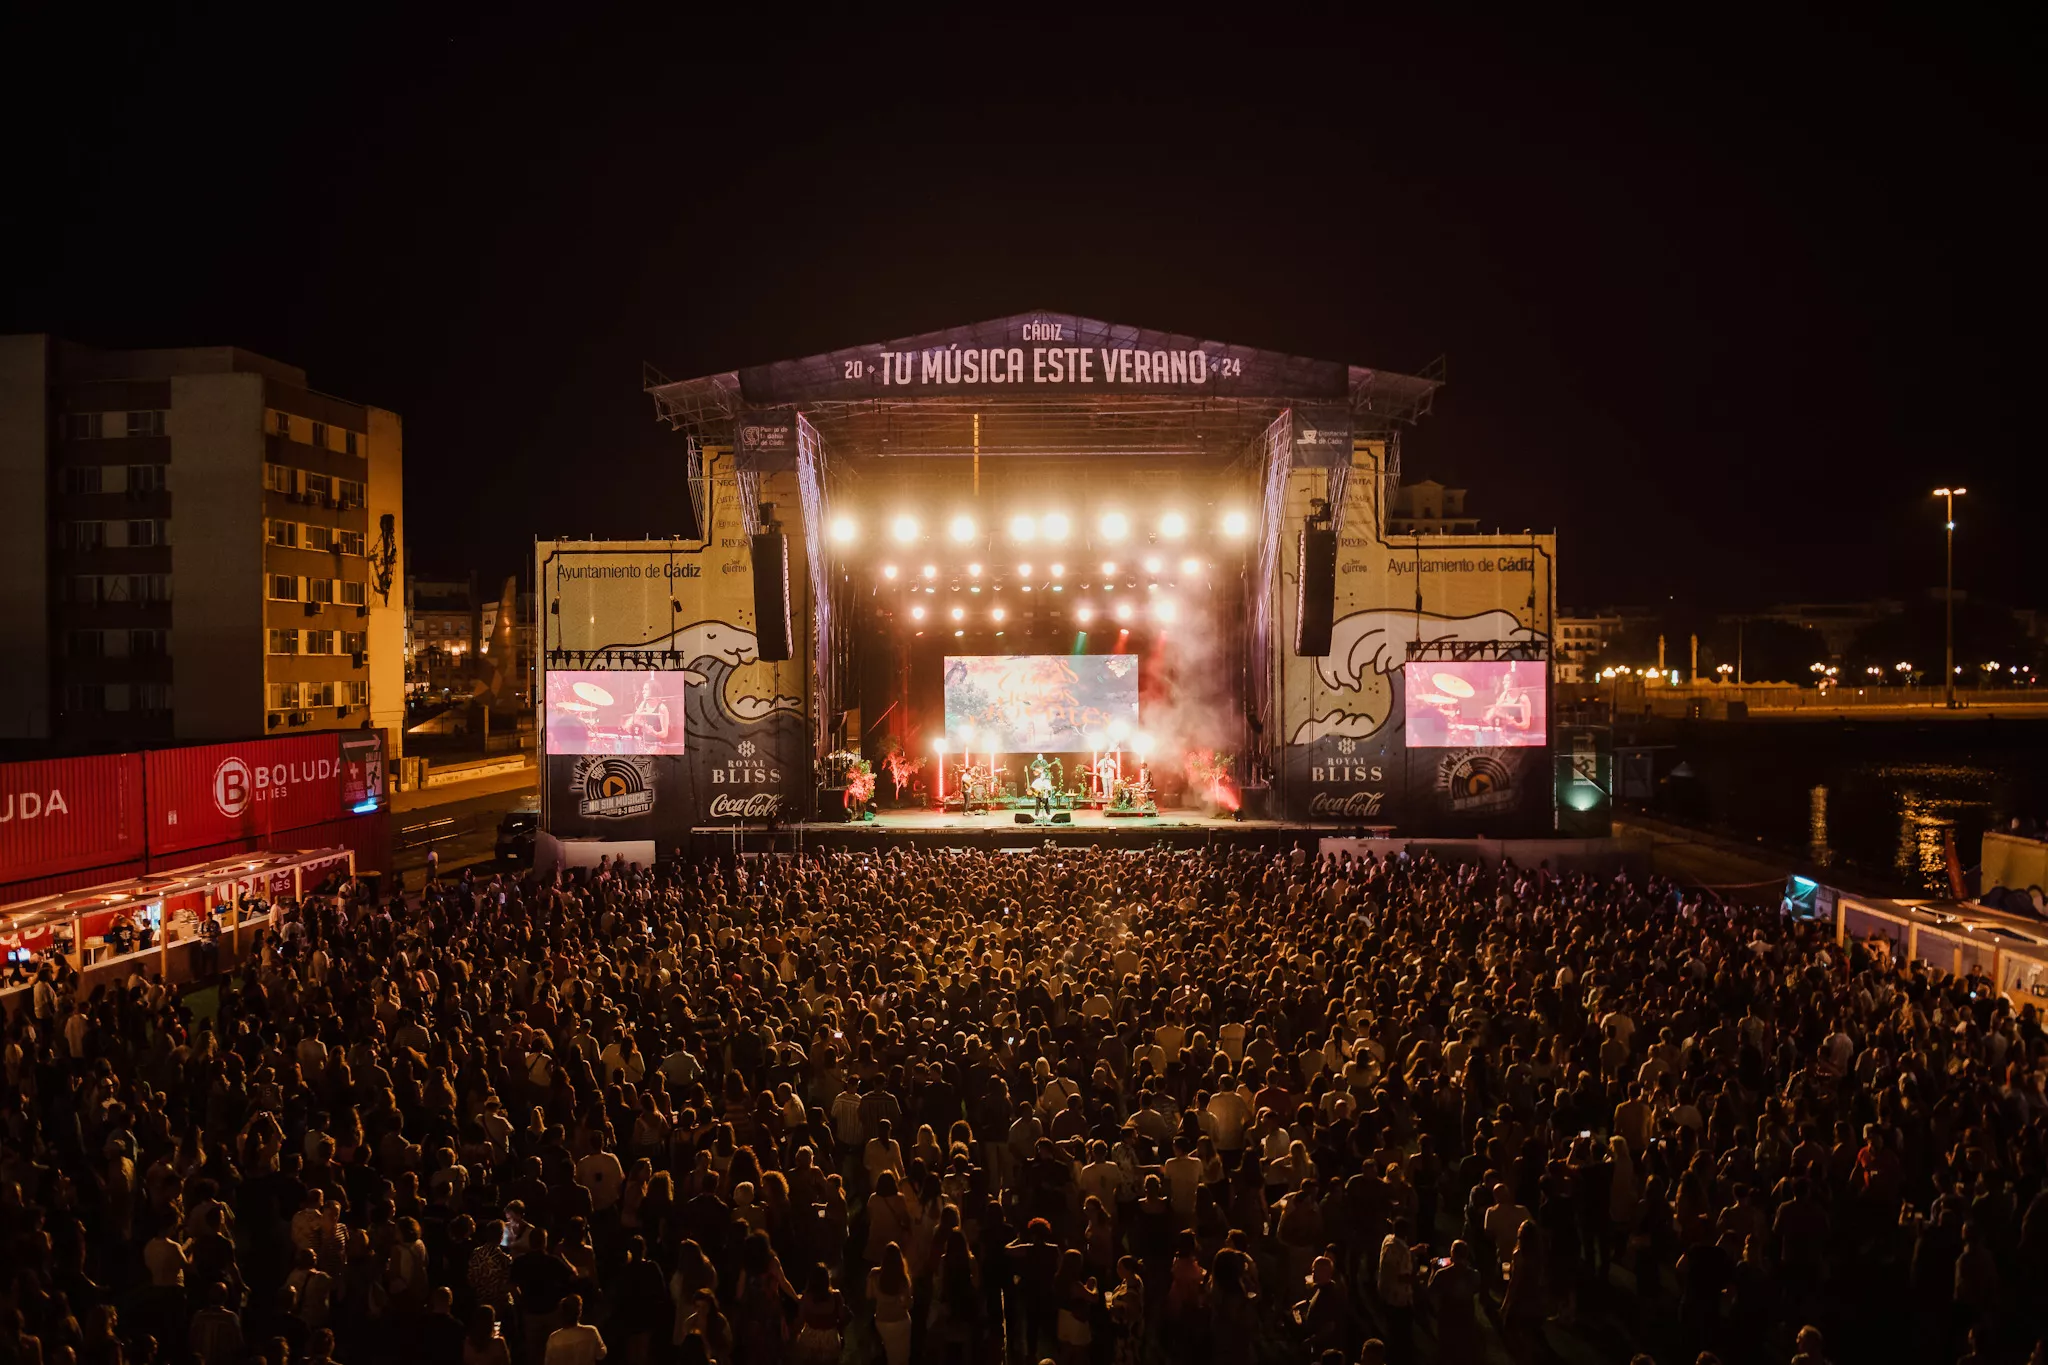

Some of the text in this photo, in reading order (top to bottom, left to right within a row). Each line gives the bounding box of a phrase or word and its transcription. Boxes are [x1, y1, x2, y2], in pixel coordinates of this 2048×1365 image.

[1022, 320, 1063, 341] CÁDIZ
[845, 343, 1242, 386] 20 TU MÚSICA ESTE VERANO 24
[721, 538, 748, 547] RIVES
[558, 563, 701, 581] Ayuntamiento de Cádiz
[1387, 556, 1535, 576] Ayuntamiento de Cádiz
[727, 759, 766, 768] ROYAL
[712, 768, 782, 784] BLISS
[1312, 766, 1383, 782] BLISS
